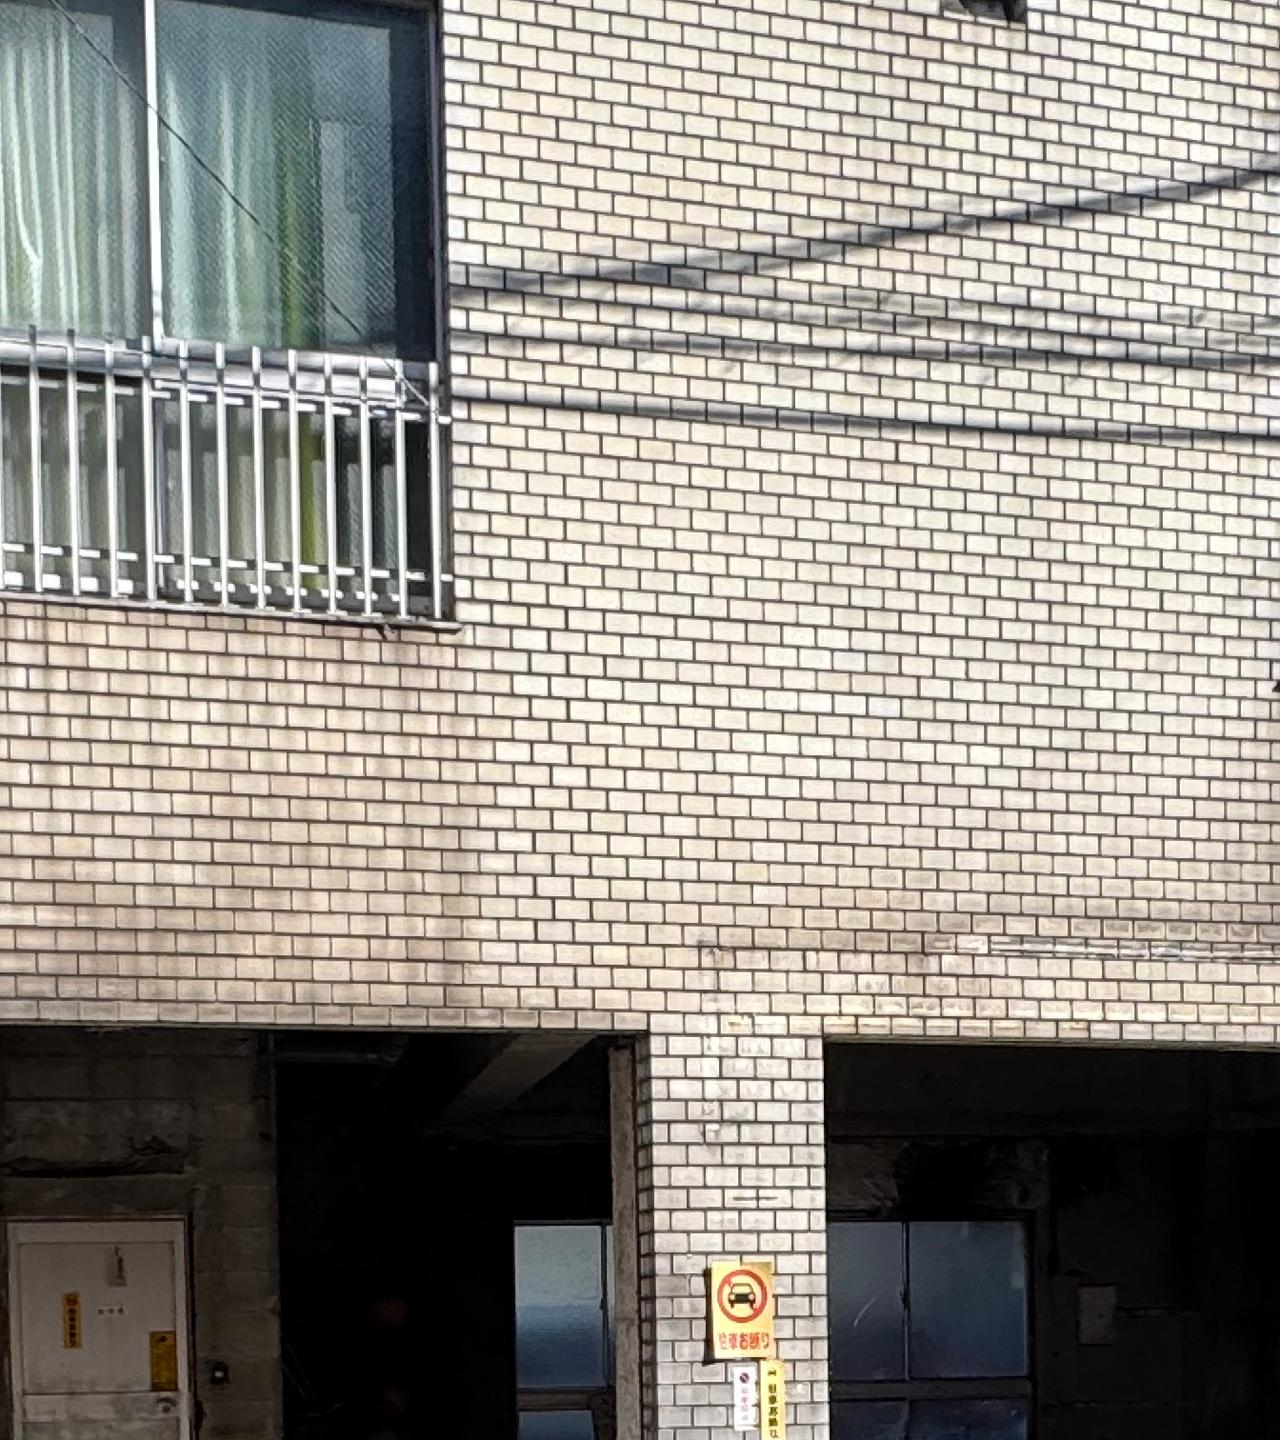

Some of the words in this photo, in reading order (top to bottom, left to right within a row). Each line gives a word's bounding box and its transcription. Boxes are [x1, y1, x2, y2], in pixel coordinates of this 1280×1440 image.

[718, 1332, 770, 1350] 駐車お断り
